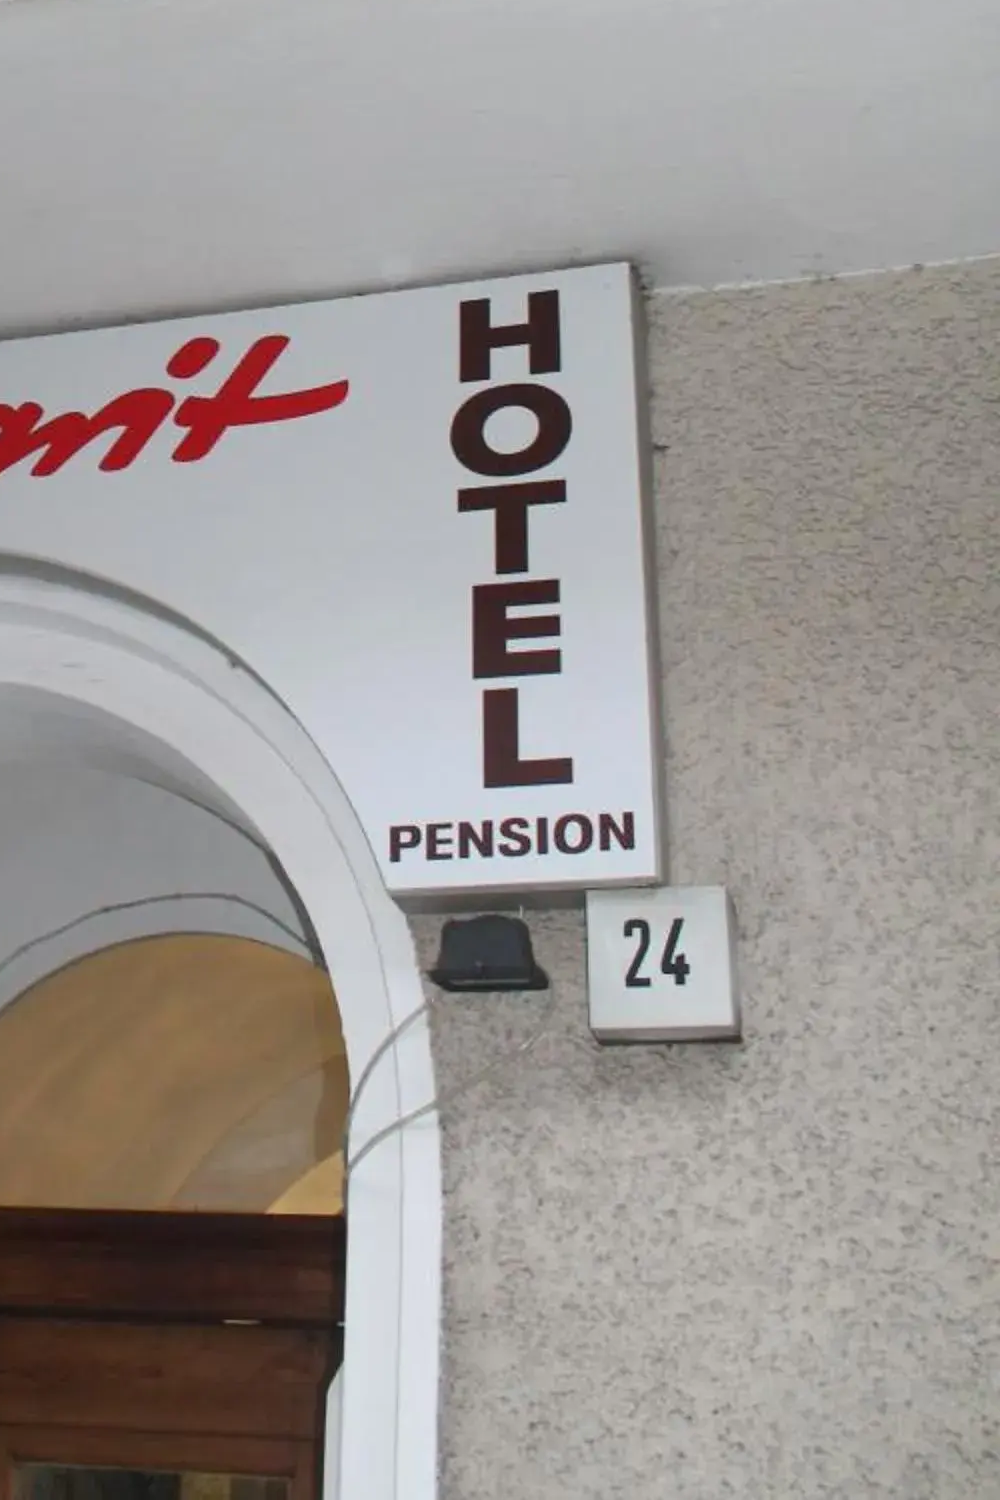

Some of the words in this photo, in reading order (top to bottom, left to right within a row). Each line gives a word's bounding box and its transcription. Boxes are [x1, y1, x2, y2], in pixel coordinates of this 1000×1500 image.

[450, 289, 574, 789] HOTEL
[389, 811, 635, 863] PENSION
[623, 917, 690, 989] 24
